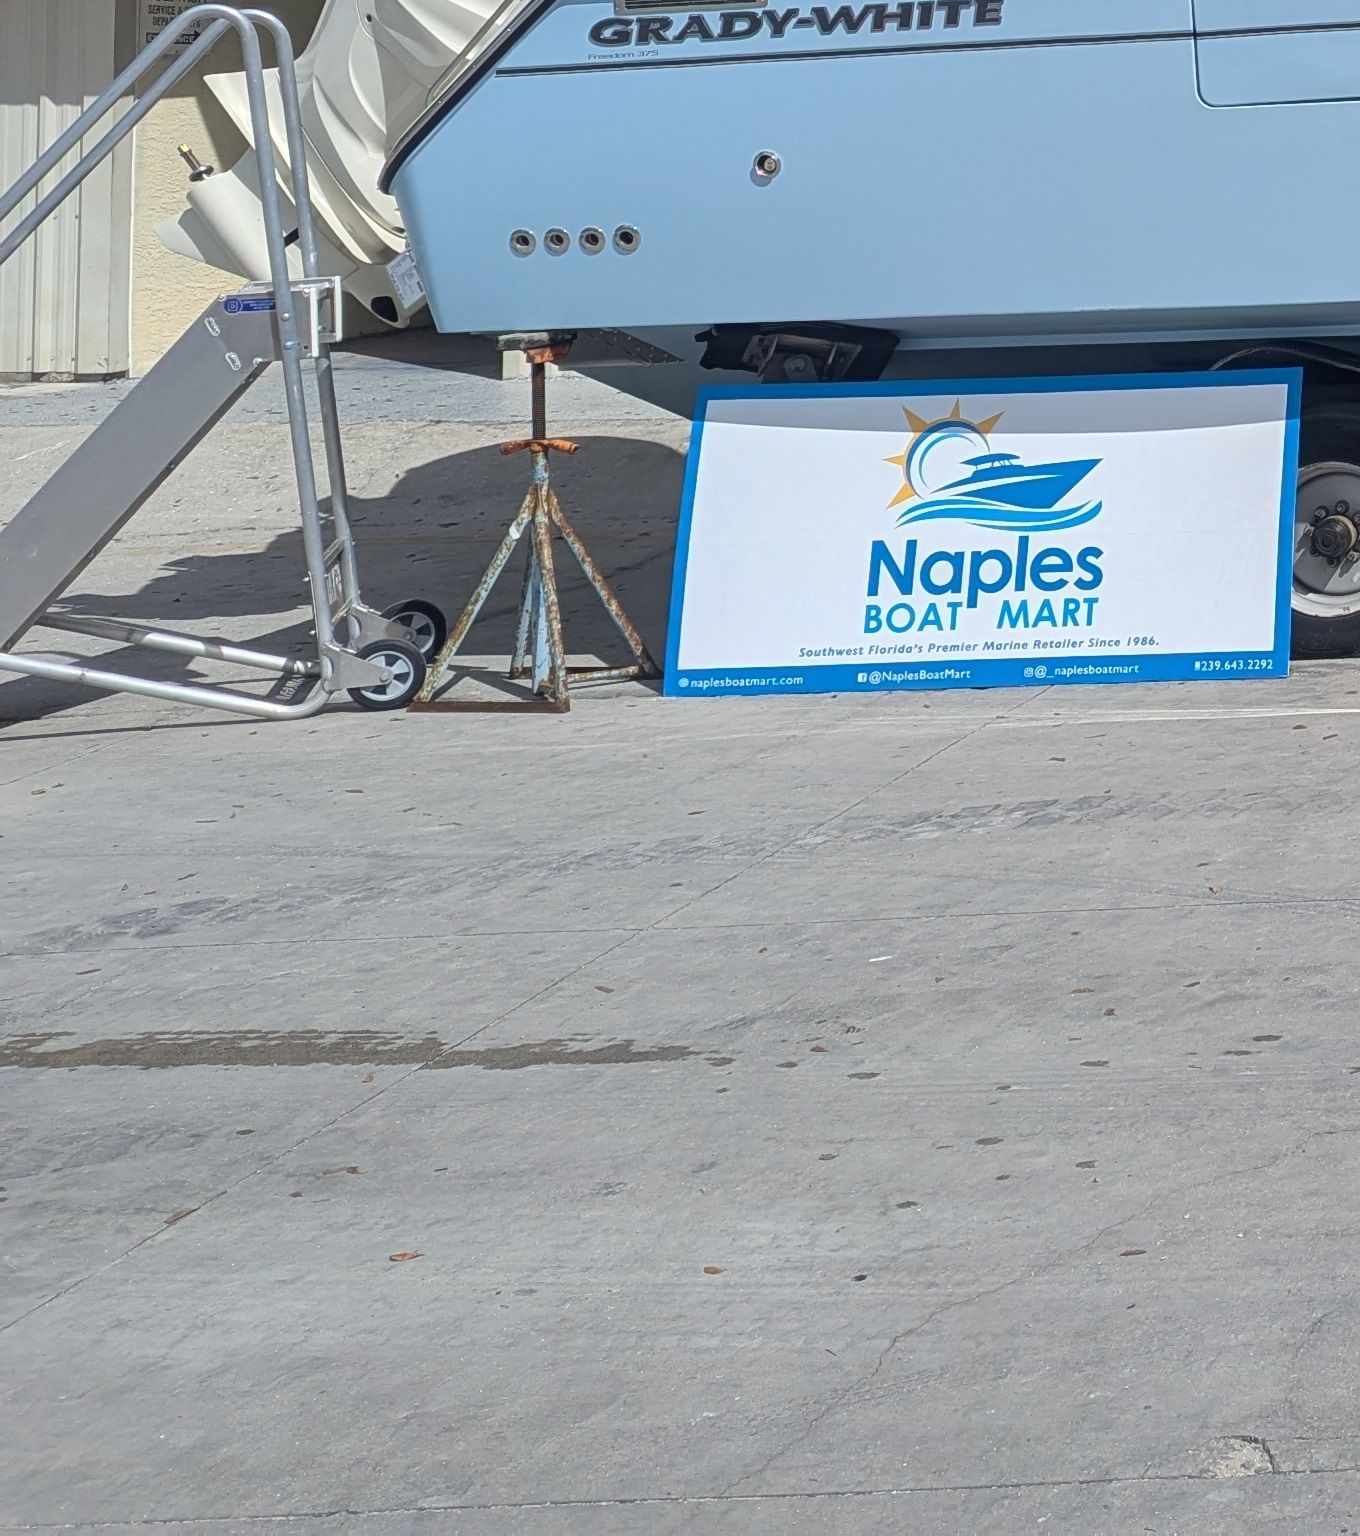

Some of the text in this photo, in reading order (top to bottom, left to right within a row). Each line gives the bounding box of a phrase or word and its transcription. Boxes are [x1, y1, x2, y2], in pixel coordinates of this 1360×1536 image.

[866, 535, 1104, 609] Naples
[863, 597, 1099, 634] BOAT MART
[798, 636, 1160, 658] Southwest Florida's Premier Marine Retailer Since 1986.
[1201, 659, 1274, 672] 239.643.2292
[690, 675, 804, 690] naplesboatmart.com
[868, 667, 971, 684] @NaplesBoatMart
